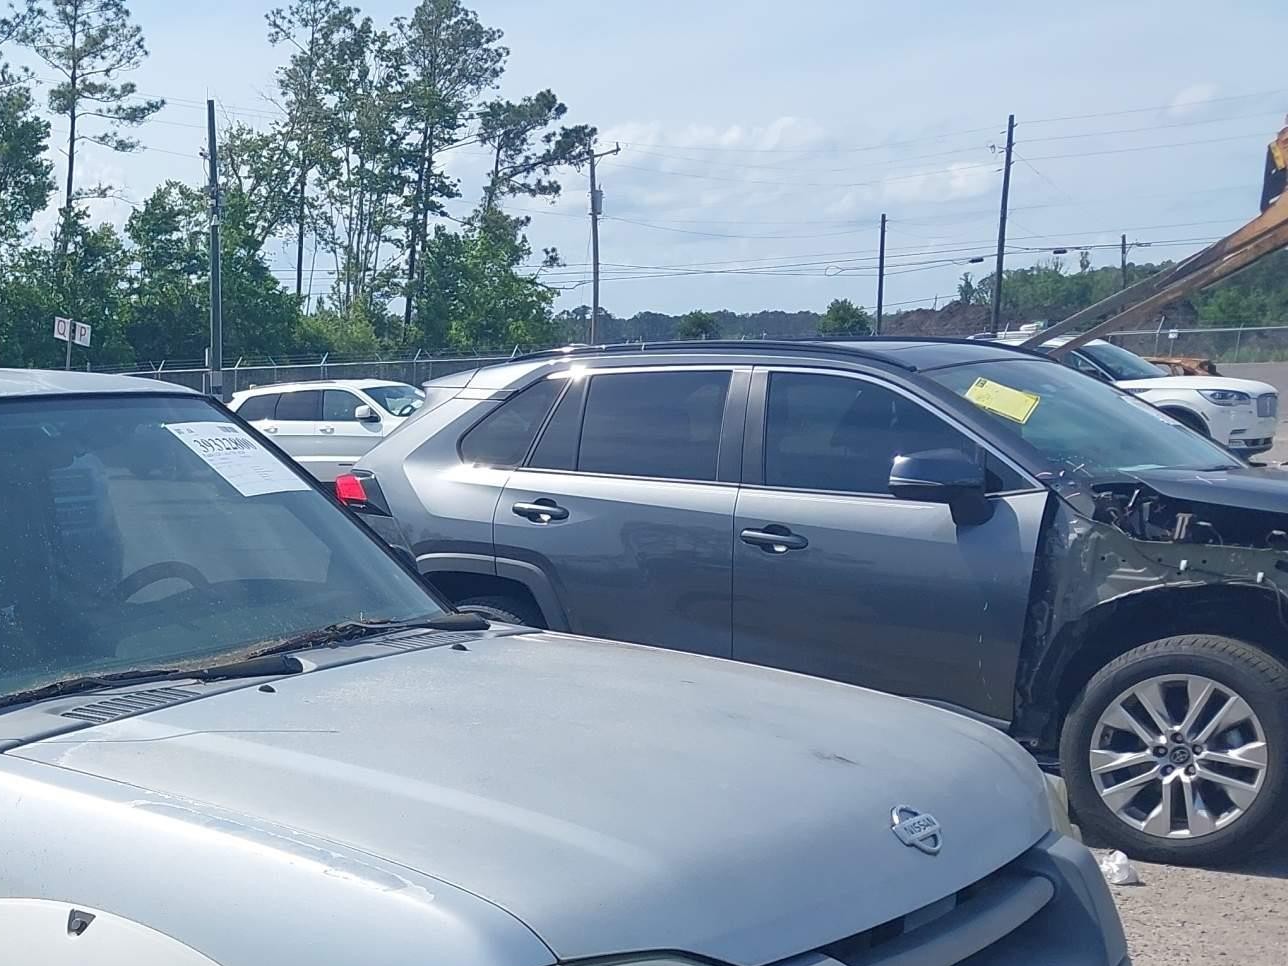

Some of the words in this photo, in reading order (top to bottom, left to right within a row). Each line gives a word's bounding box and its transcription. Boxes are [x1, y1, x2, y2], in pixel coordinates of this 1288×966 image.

[57, 319, 67, 338] Q
[79, 326, 87, 342] P
[194, 436, 258, 453] 39322800
[903, 816, 937, 836] NISSAN
